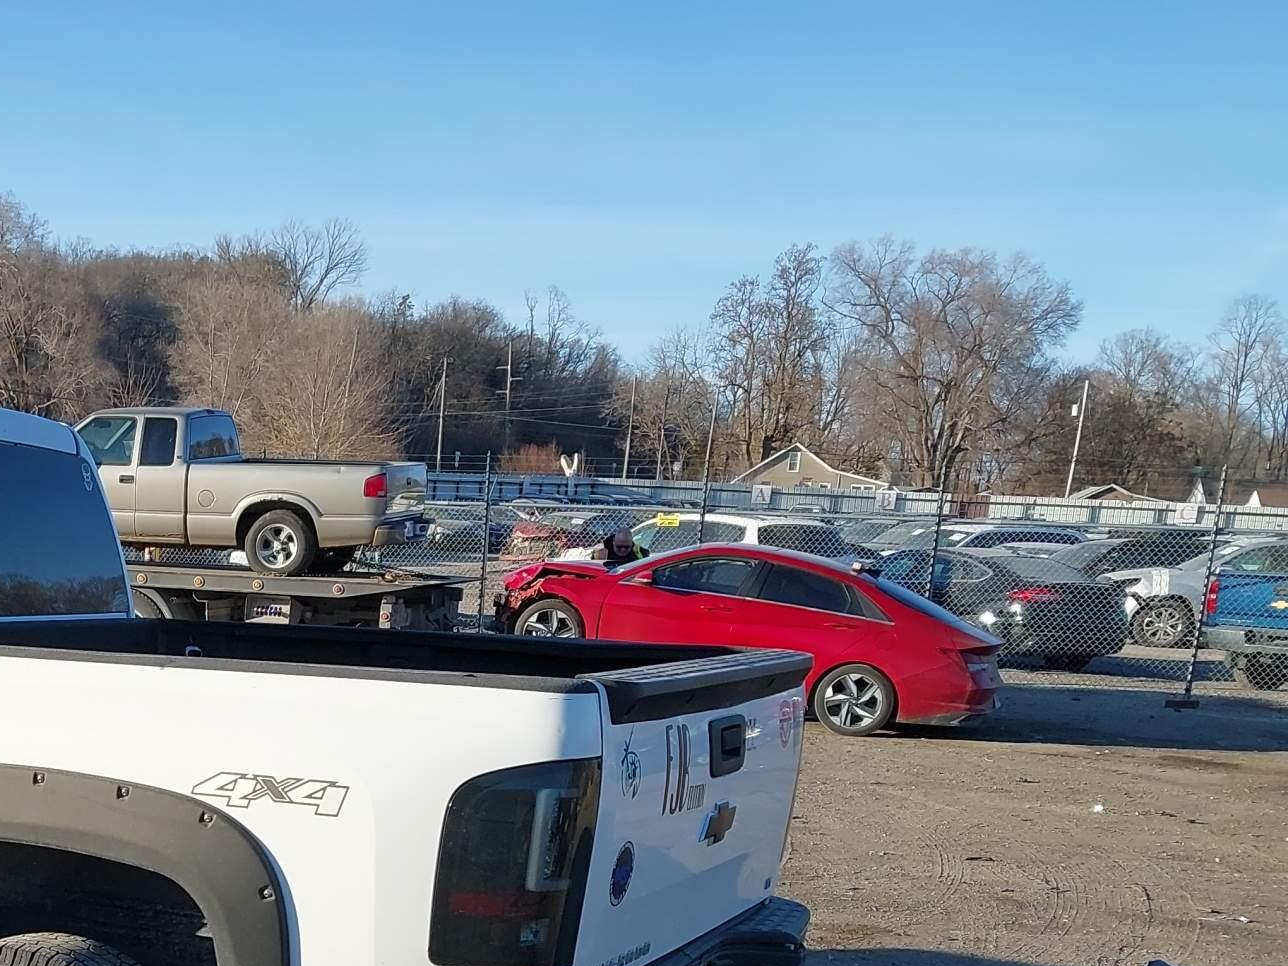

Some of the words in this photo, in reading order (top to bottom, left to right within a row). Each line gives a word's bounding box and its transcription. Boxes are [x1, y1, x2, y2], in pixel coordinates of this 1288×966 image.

[755, 487, 767, 503] A
[878, 492, 891, 508] B
[1180, 505, 1194, 520] C
[661, 723, 692, 816] FJB
